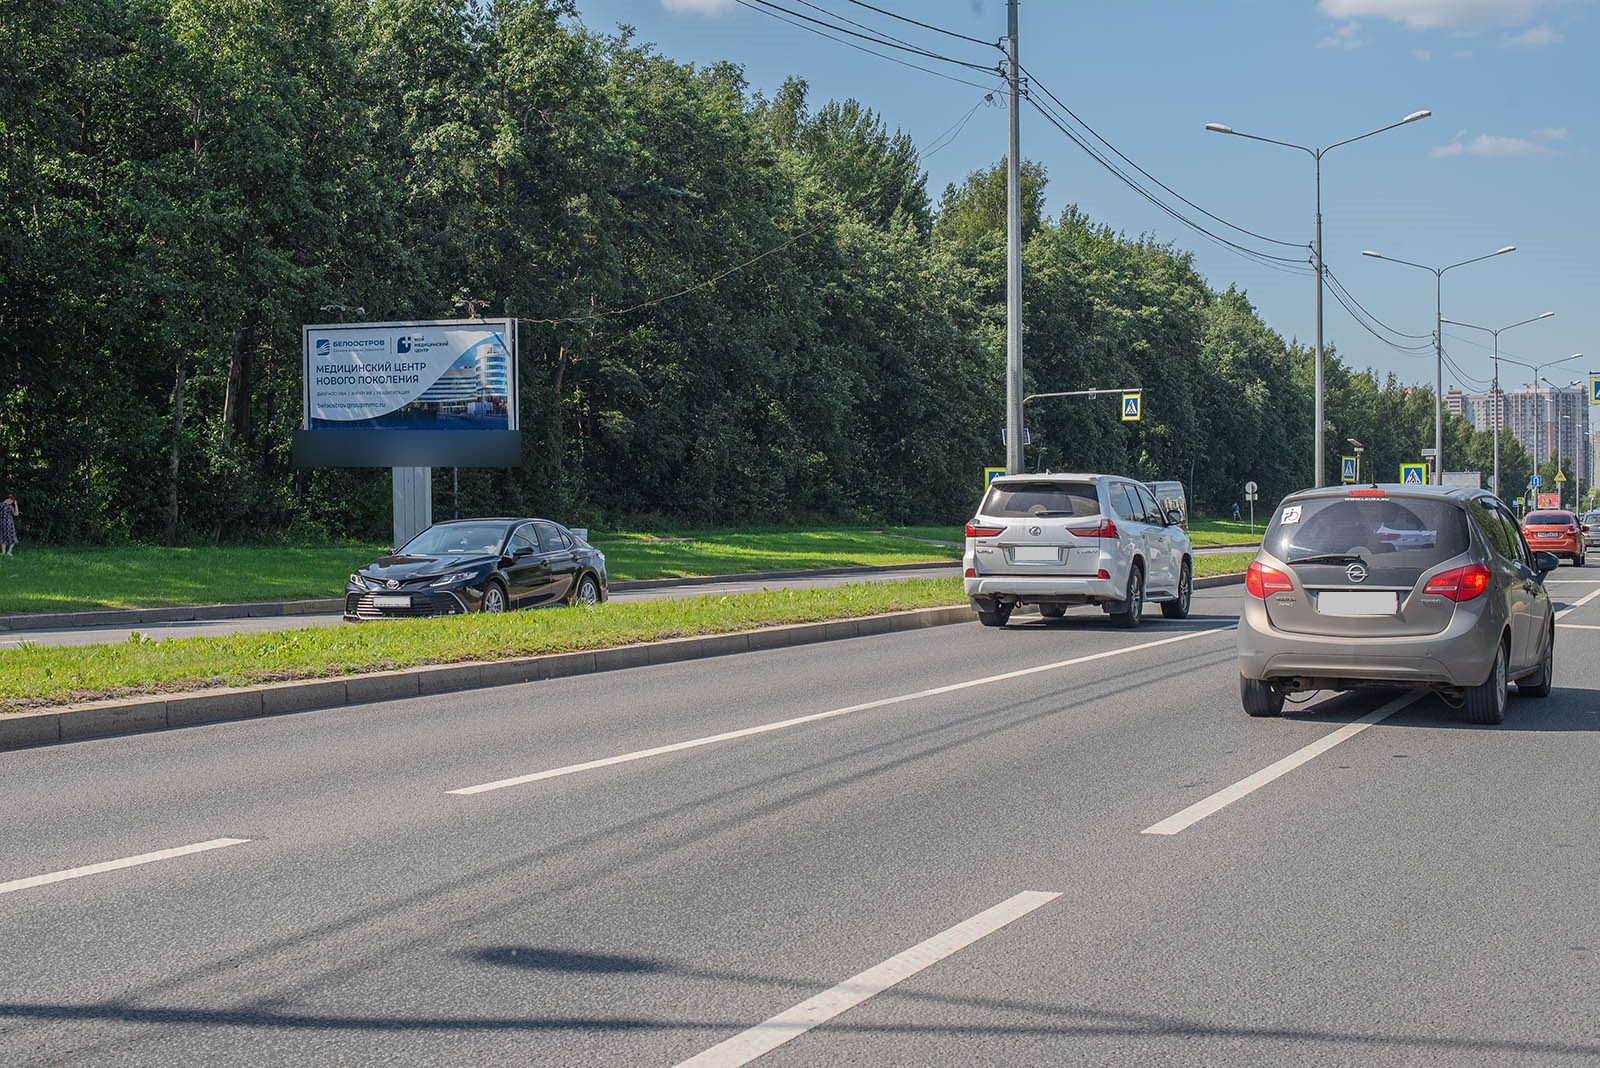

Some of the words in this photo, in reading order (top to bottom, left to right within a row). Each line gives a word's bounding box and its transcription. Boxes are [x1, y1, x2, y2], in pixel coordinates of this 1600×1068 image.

[316, 362, 392, 374] МЕДИЦИНСКИЙ
[394, 362, 427, 373] ЦЕНТР
[316, 376, 356, 385] НОВОГО
[358, 375, 419, 385] ПОКОЛЕНИЯ
